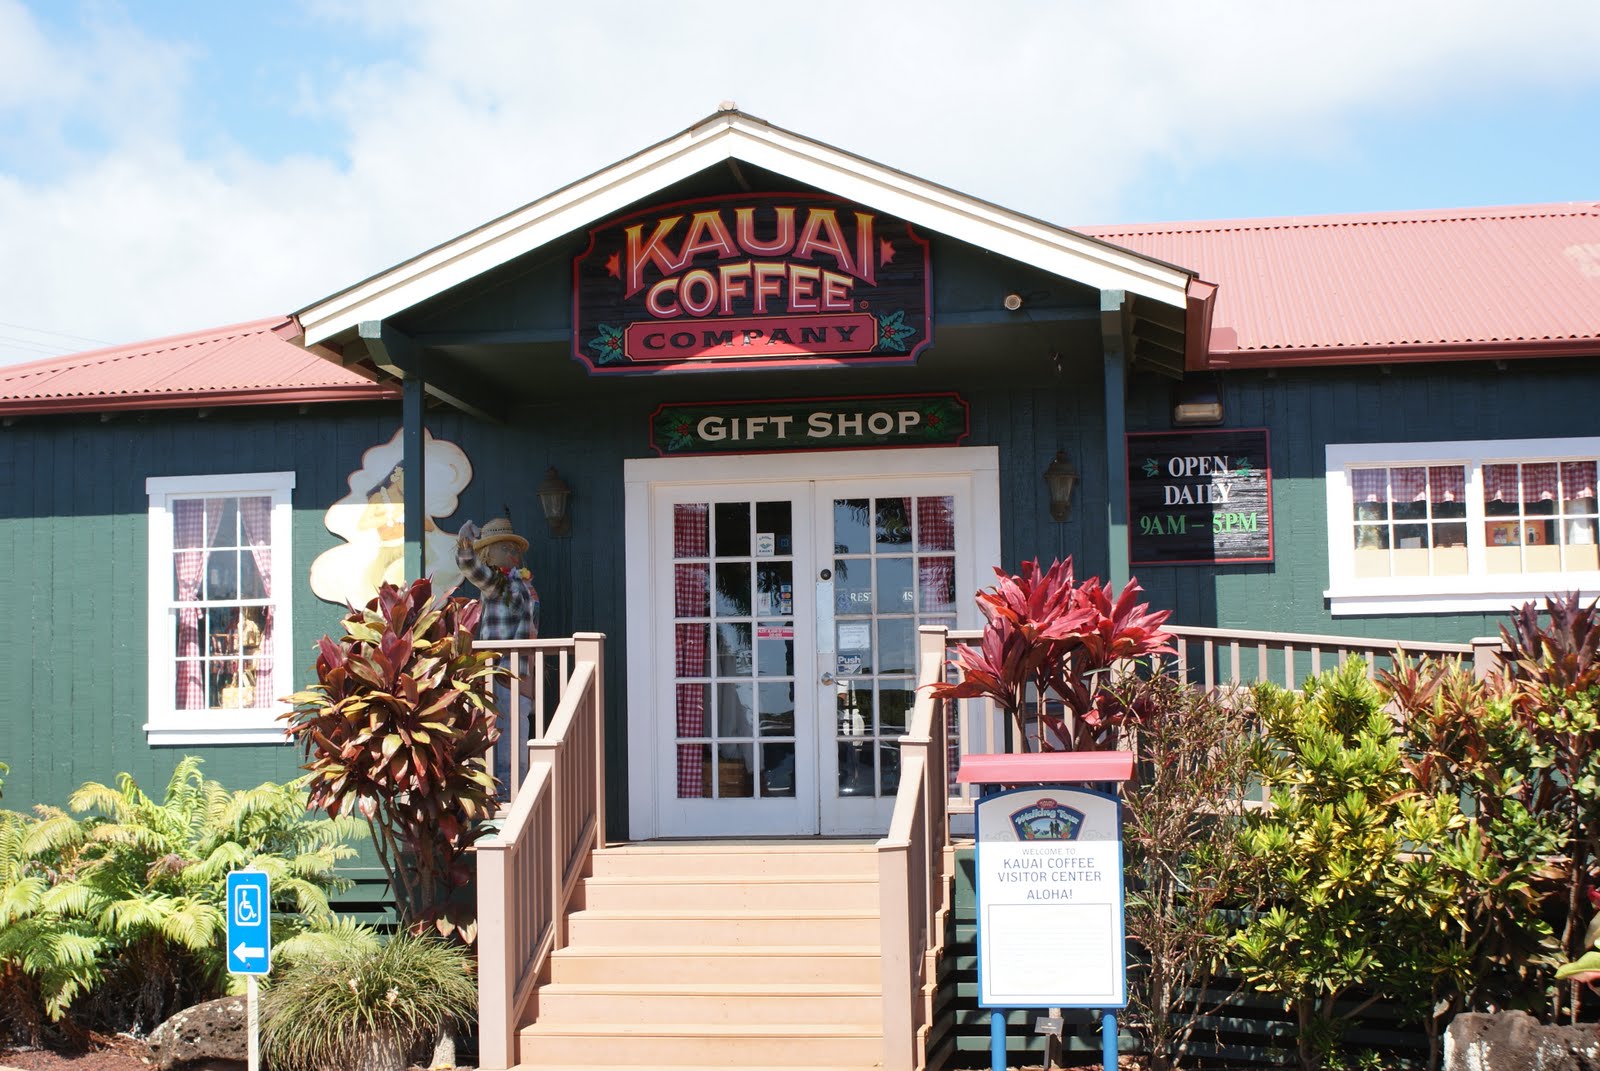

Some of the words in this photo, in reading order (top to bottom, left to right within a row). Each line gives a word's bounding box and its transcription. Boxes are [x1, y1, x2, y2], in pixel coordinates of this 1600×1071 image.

[624, 206, 878, 300] KAUAI
[645, 260, 855, 318] COFFEE
[642, 325, 861, 350] COMPANY
[696, 413, 793, 441] GIFT
[807, 411, 921, 438] SHOP
[1168, 455, 1229, 477] OPEN
[1163, 483, 1233, 505] DAILY
[1140, 514, 1187, 535] 9AM
[1212, 512, 1259, 534] 5PM
[837, 655, 861, 665] Push
[1015, 808, 1057, 825] Walking
[1056, 809, 1079, 825] Tour
[1003, 858, 1043, 869] KAUAI
[1047, 857, 1095, 869] COFFEE
[1021, 848, 1063, 856] WELCOME
[1065, 848, 1076, 856] TO
[997, 871, 1047, 882] VISITOR
[1051, 871, 1102, 882] CENTER
[1026, 889, 1073, 900] ALOHA!
